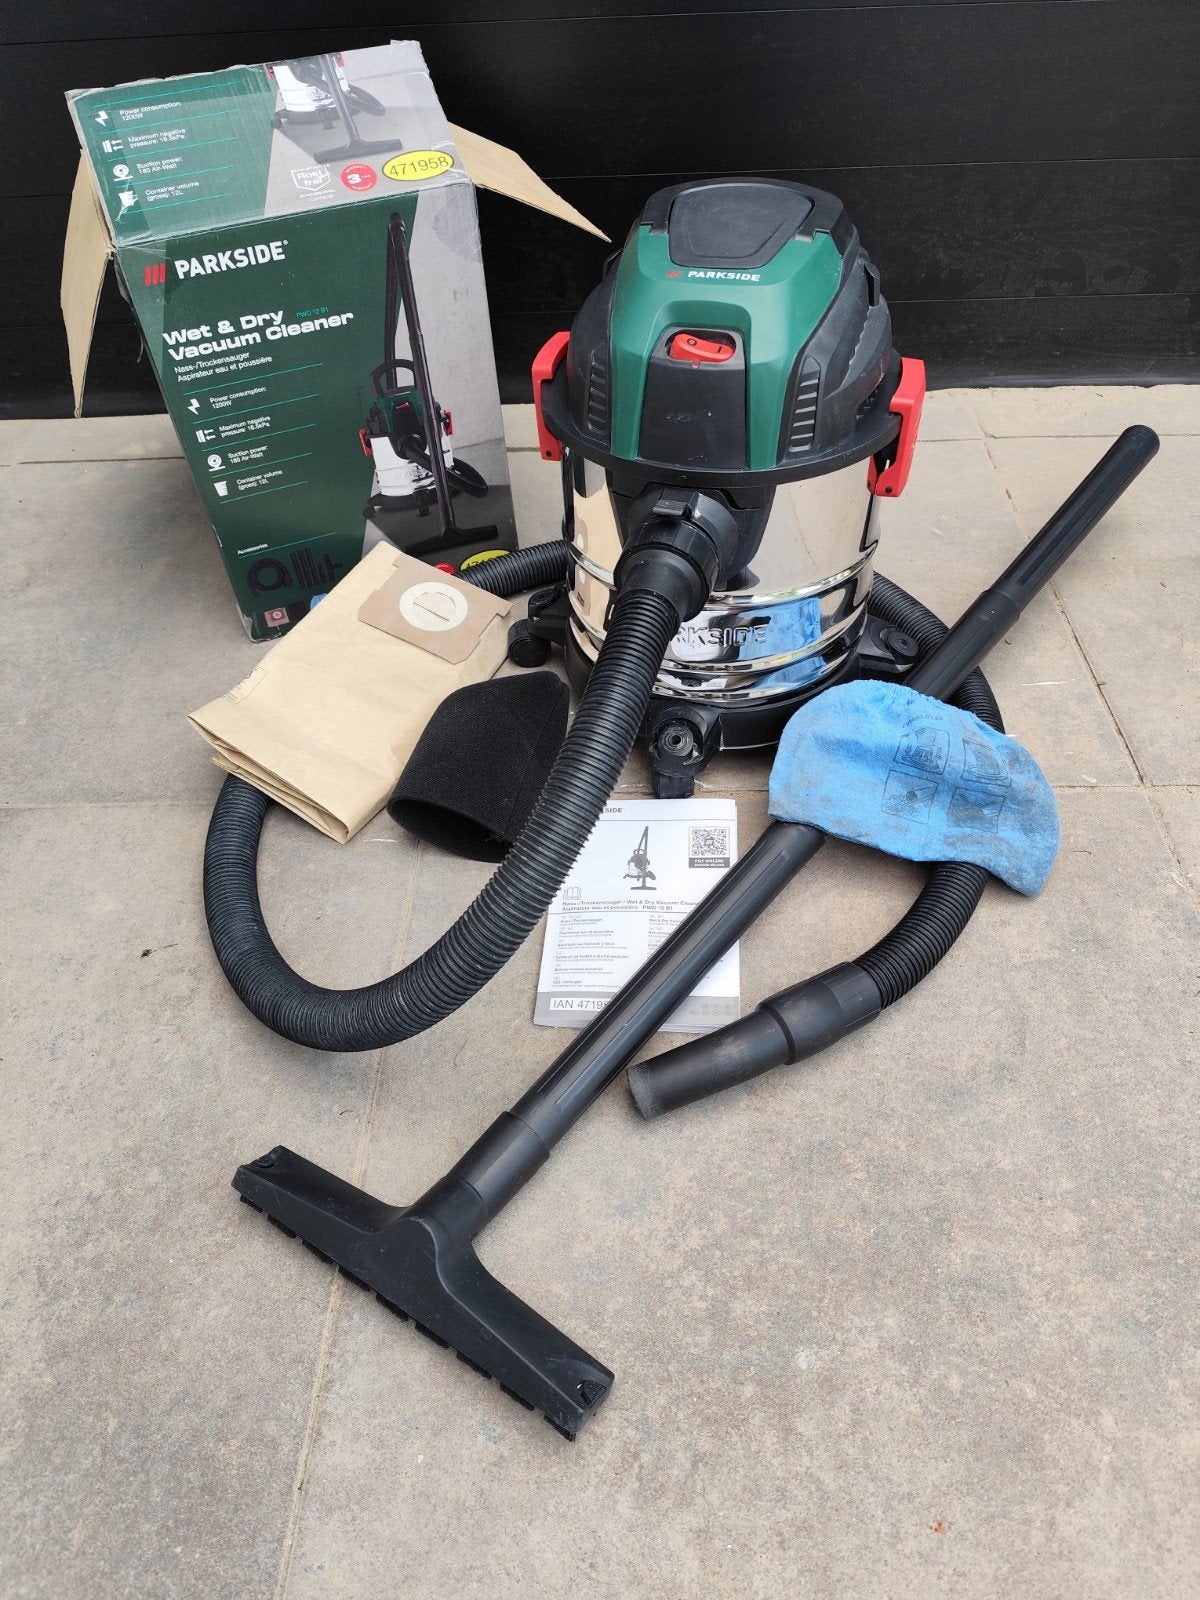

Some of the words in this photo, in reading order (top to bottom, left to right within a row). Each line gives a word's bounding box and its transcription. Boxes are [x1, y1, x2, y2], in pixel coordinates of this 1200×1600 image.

[119, 107, 140, 116] Power
[140, 101, 182, 112] consumption:
[128, 131, 159, 143] Maximum
[159, 128, 186, 138] negative
[130, 139, 159, 149] pressure:
[137, 160, 160, 170] Suction
[161, 156, 183, 167] power:
[389, 156, 449, 177] 471958
[347, 173, 362, 184] 3
[145, 186, 176, 196] Container
[176, 181, 200, 190] volume
[174, 240, 286, 279] PARKSIDE
[687, 270, 761, 282] PARKSIDE
[162, 324, 212, 346] Wet
[217, 320, 236, 335] &
[239, 311, 284, 330] Dry
[168, 331, 261, 361] Vacuum
[265, 312, 354, 341] Cleaner
[174, 352, 250, 374] Nass-/Trockensauger
[177, 368, 214, 383] Aspirateur
[215, 365, 229, 374] eau
[229, 362, 238, 371] et
[238, 356, 273, 371] poussière
[209, 395, 229, 404] Power
[229, 386, 267, 400] consumption:
[218, 421, 246, 432] Maximum
[247, 416, 271, 426] negative
[221, 427, 247, 438] pressure:
[227, 450, 249, 459] Suction
[249, 446, 268, 457] power:
[241, 452, 264, 462] Air-Watt
[236, 475, 263, 485] Container
[263, 469, 283, 479] volume
[237, 543, 268, 555] Accessories
[553, 999, 574, 1009] IAN
[577, 1000, 608, 1009] 4719
